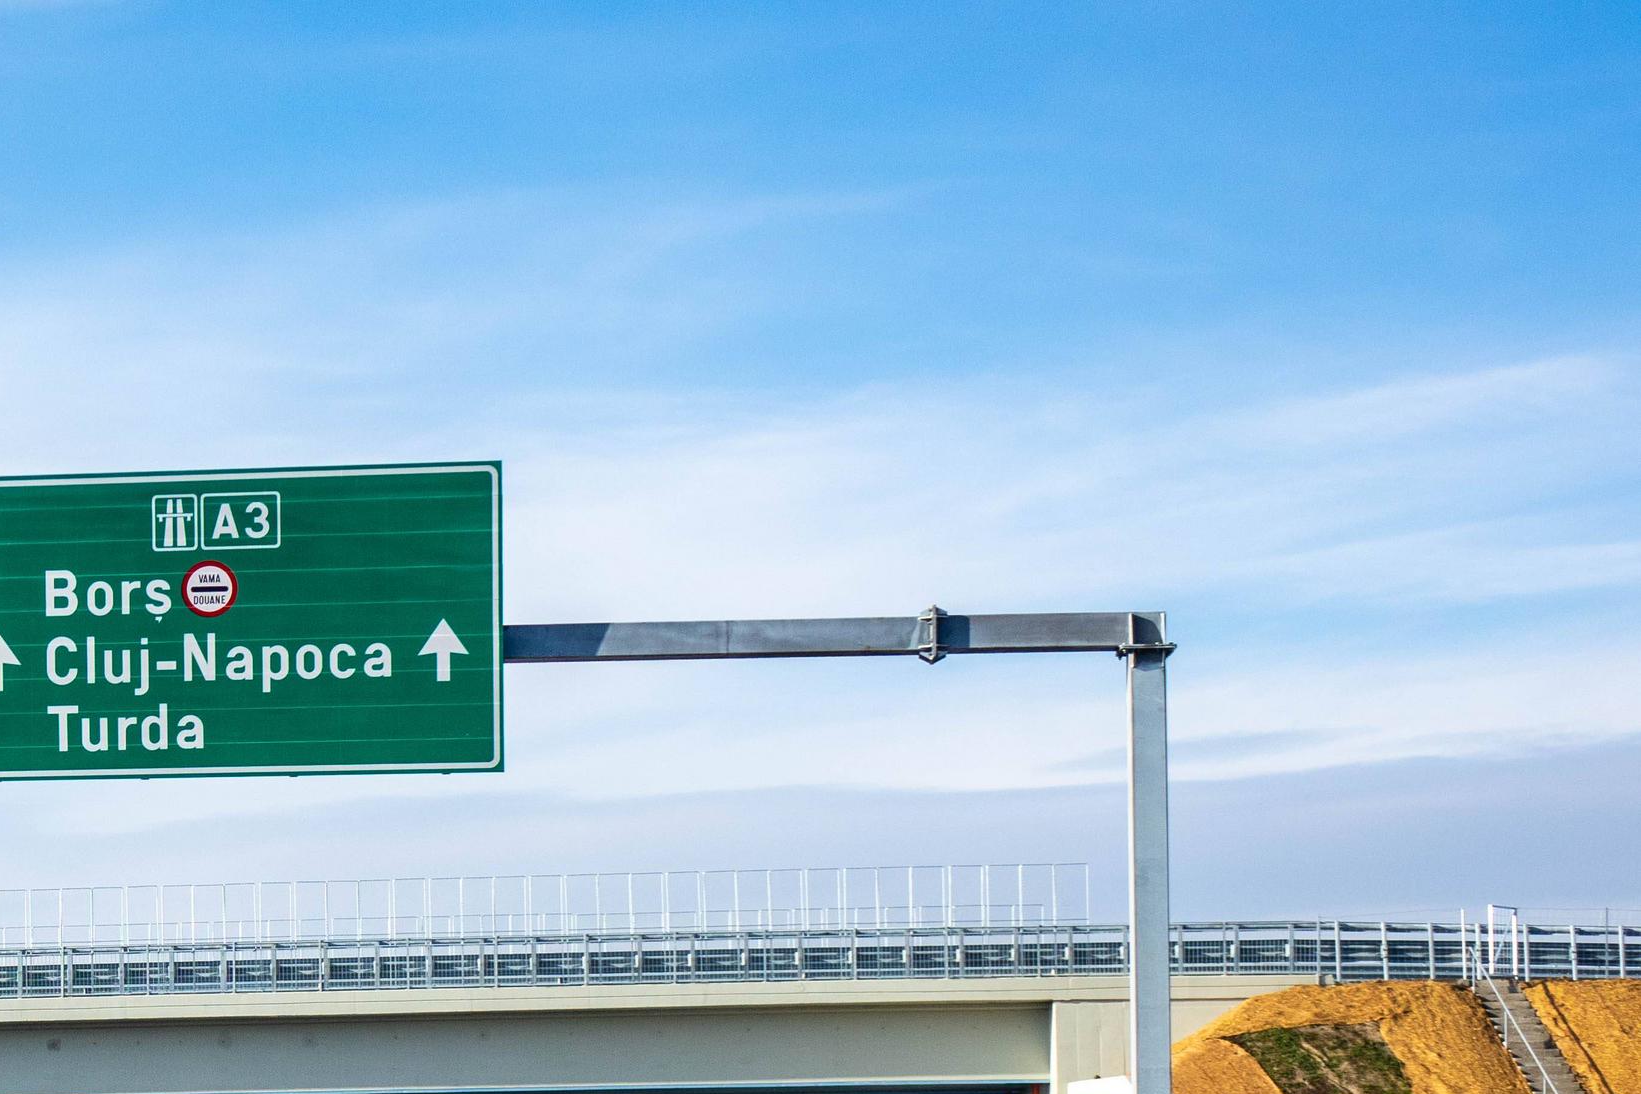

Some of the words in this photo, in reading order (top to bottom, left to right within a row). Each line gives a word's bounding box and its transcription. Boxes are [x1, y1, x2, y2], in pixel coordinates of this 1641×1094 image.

[212, 501, 270, 539] A3
[45, 569, 172, 623] Borș
[193, 594, 226, 605] DOUANE
[198, 573, 221, 584] VAMA
[46, 632, 392, 696] Cluj-Napoca
[47, 703, 205, 752] Turda
